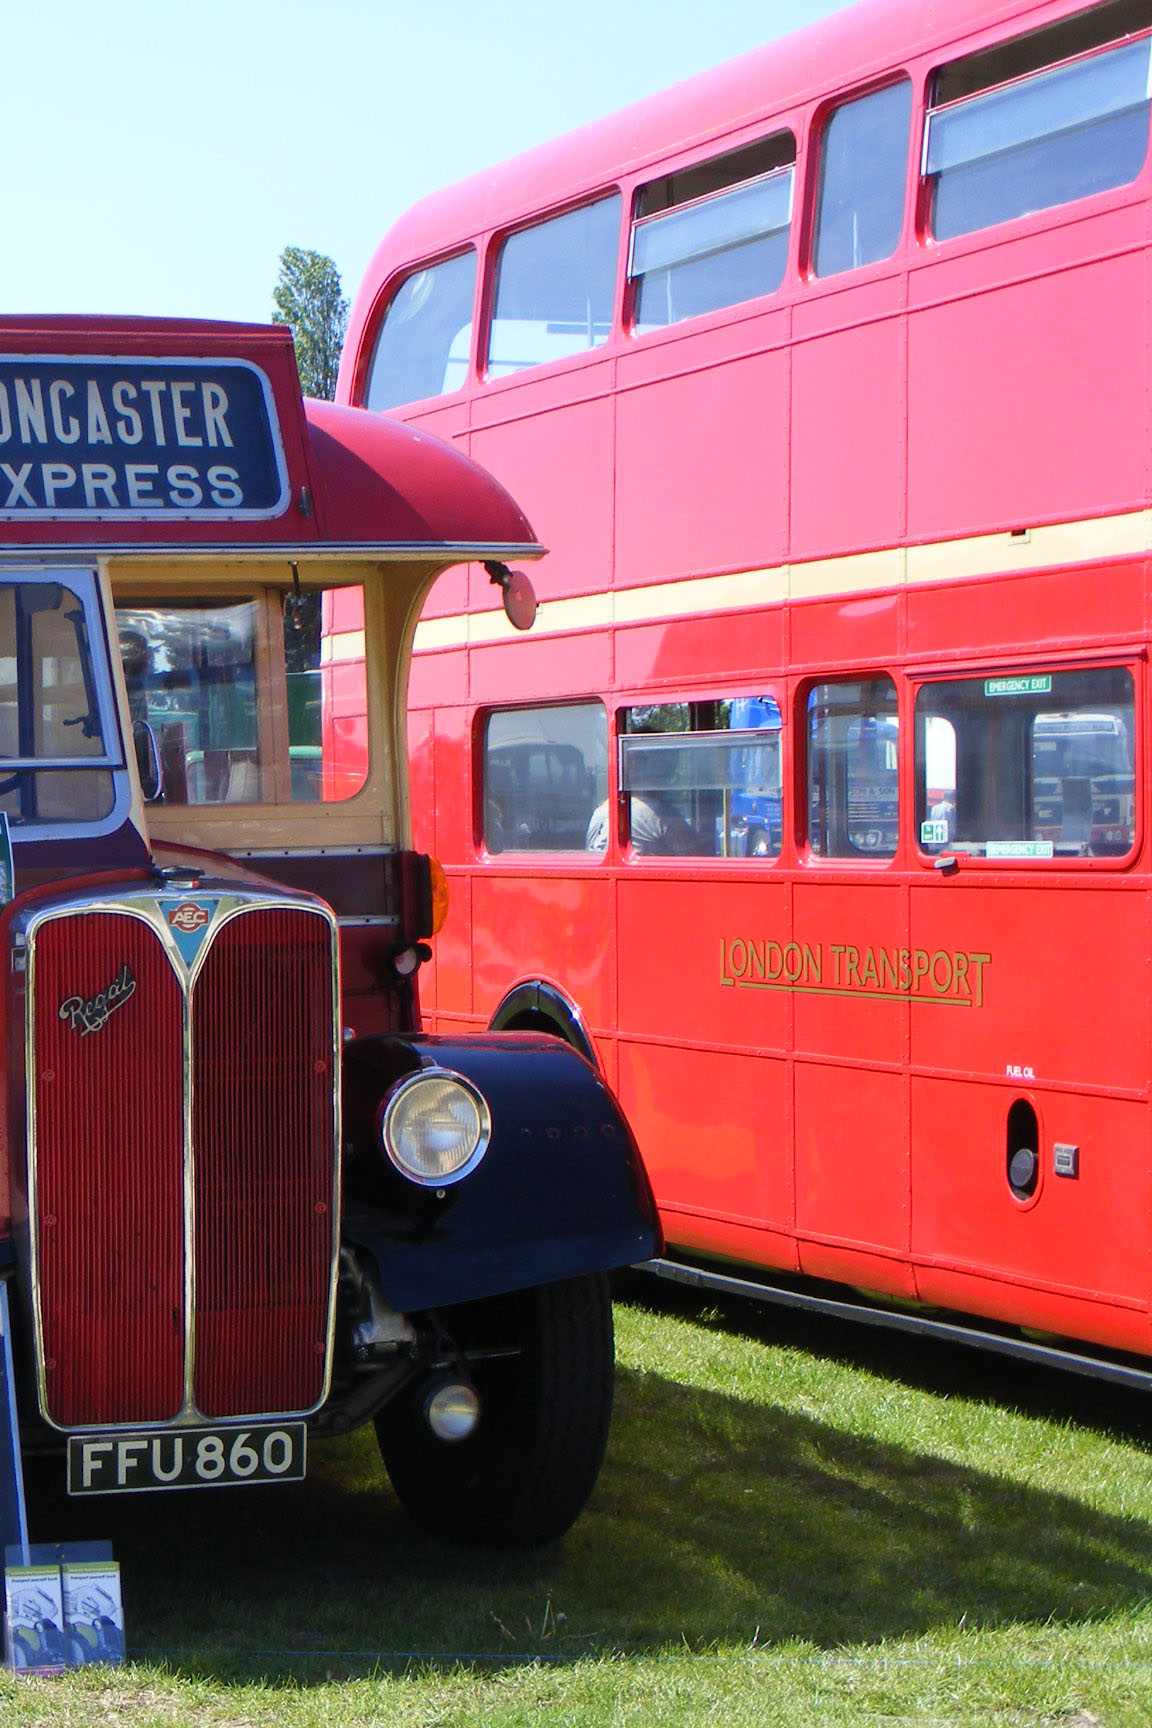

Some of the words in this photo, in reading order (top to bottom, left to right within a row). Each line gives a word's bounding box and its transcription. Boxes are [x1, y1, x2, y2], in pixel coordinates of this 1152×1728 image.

[989, 679, 1030, 693] EMERGENCY
[1032, 677, 1047, 690] EXIT
[171, 911, 206, 924] AEC
[720, 937, 823, 987] LONDON
[830, 943, 992, 1008] TRANSPORT
[59, 965, 136, 1037] Regal
[1006, 1065, 1024, 1078] FUEL
[1023, 1066, 1036, 1079] OIL
[82, 1437, 183, 1488] FFU
[195, 1430, 293, 1480] 860
